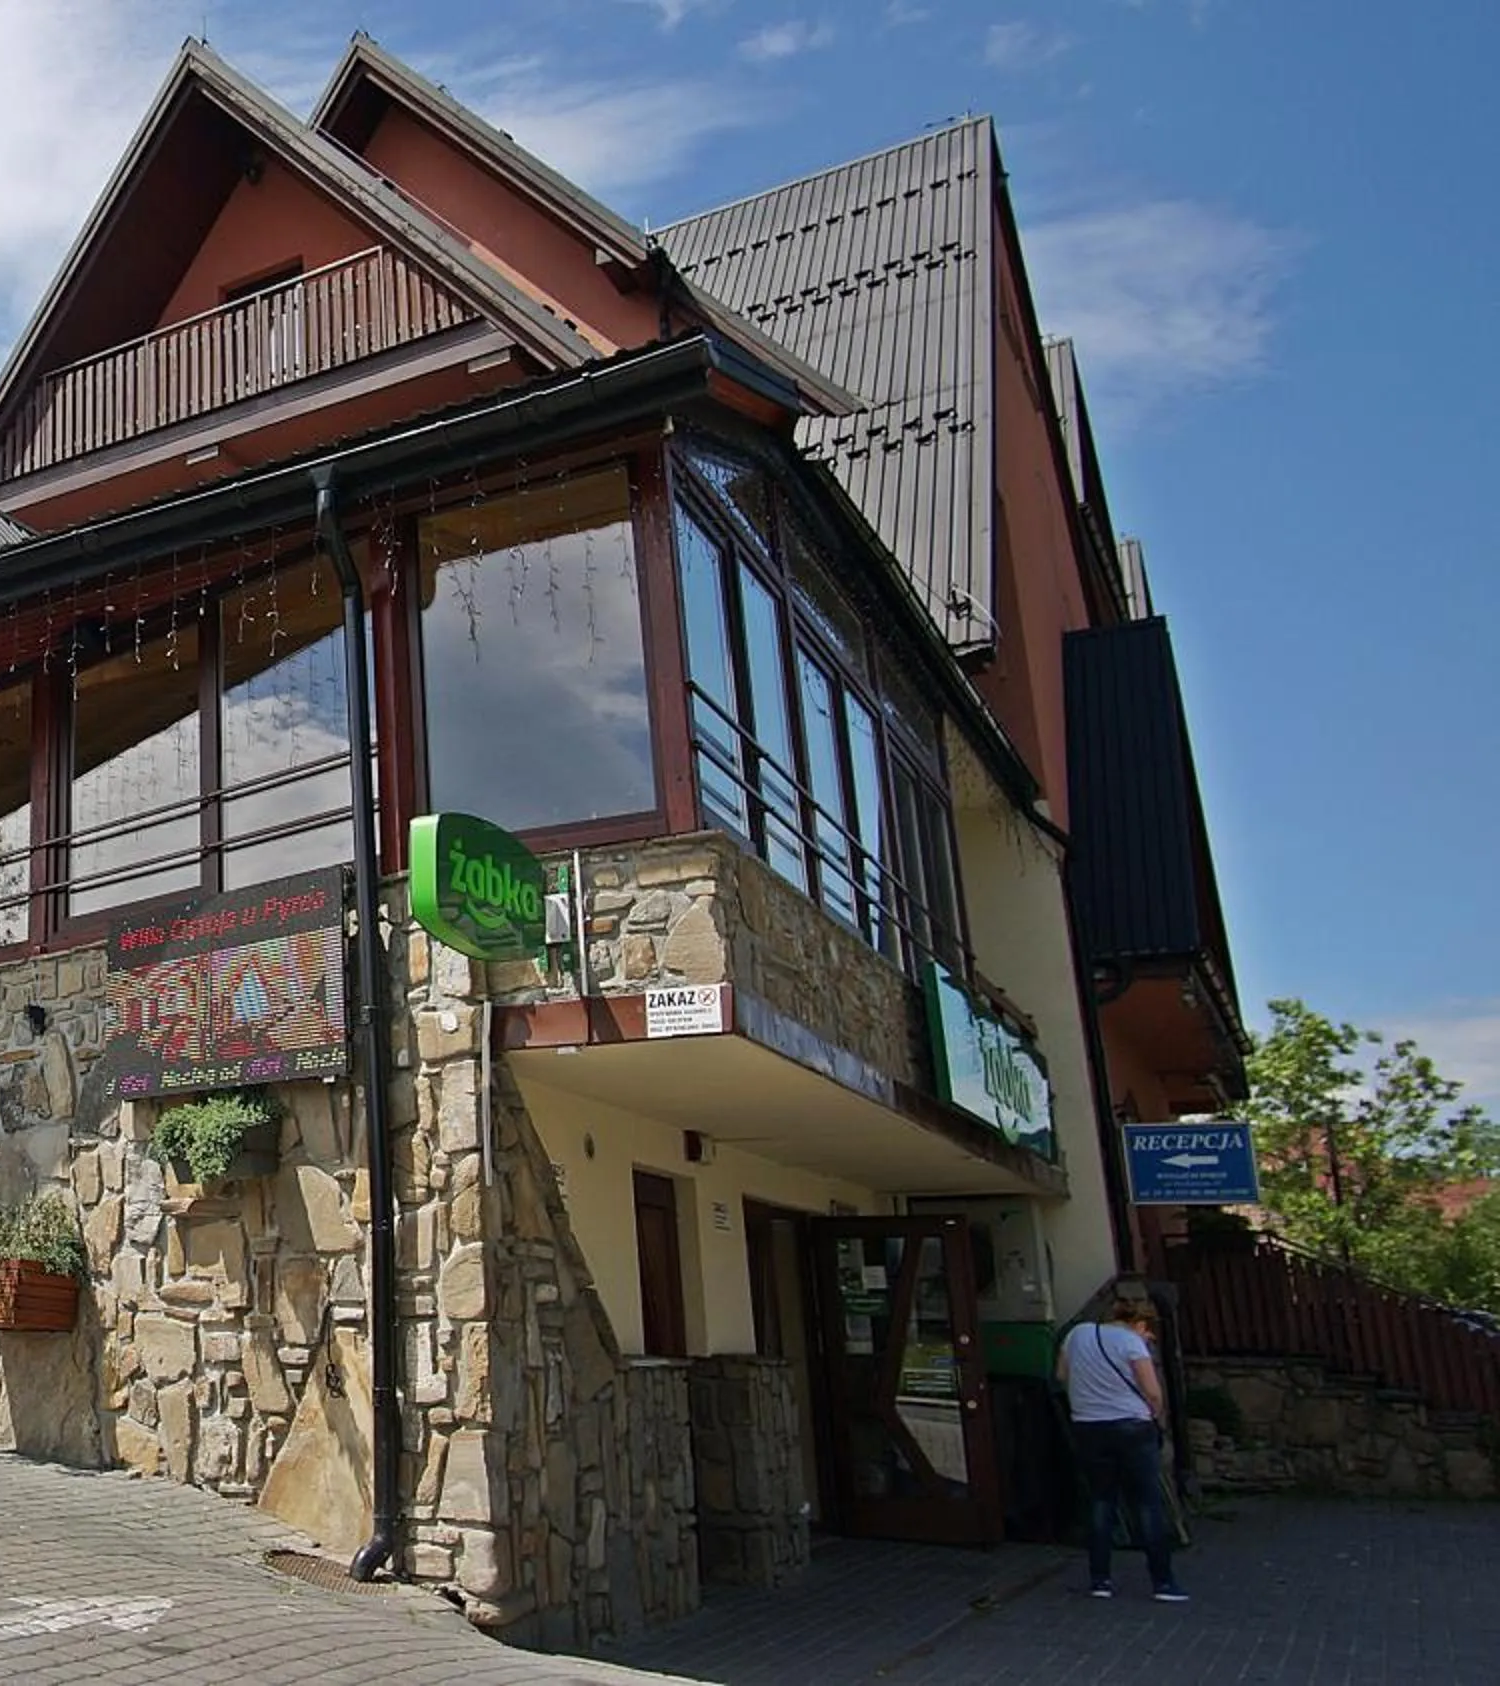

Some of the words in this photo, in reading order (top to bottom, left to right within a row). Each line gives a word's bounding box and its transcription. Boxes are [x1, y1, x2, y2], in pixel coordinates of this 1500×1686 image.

[449, 837, 539, 921] żabka
[647, 990, 697, 1009] ZAKAZ
[1132, 1132, 1245, 1151] RECEPCJA
